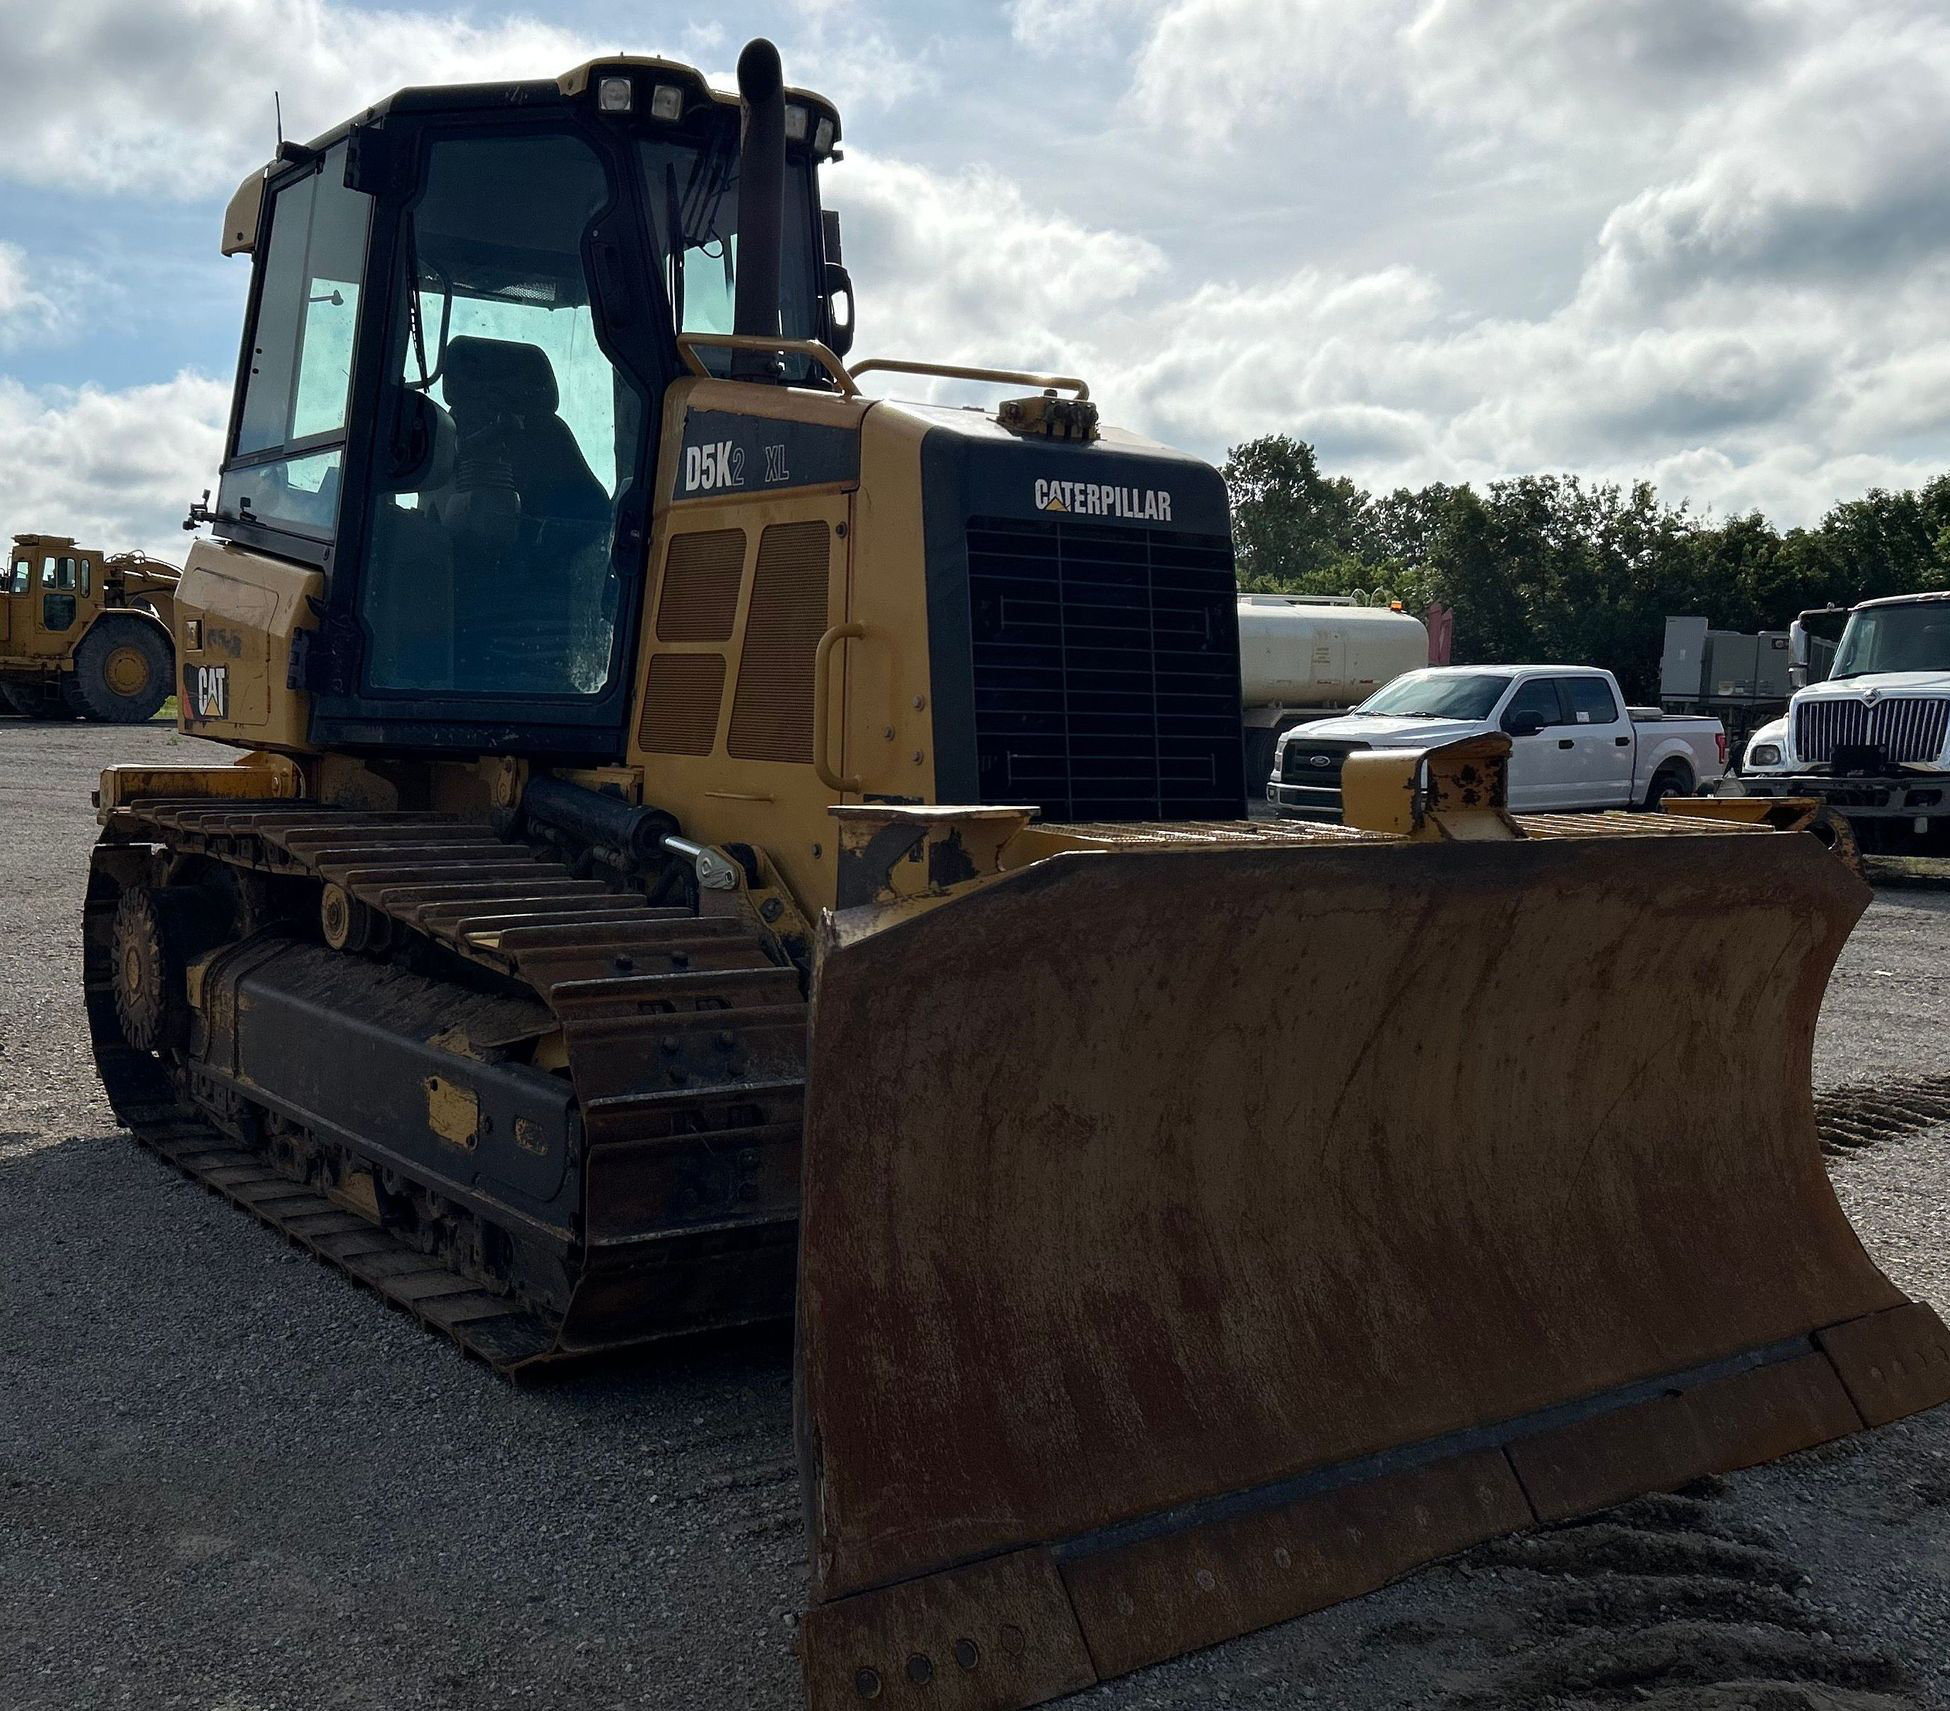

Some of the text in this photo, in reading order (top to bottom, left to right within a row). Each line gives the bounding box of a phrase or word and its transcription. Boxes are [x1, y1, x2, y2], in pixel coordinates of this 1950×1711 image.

[685, 441, 790, 491] D5K2 XL
[1035, 478, 1172, 521] CATERPILLAR
[198, 666, 225, 717] CAT
